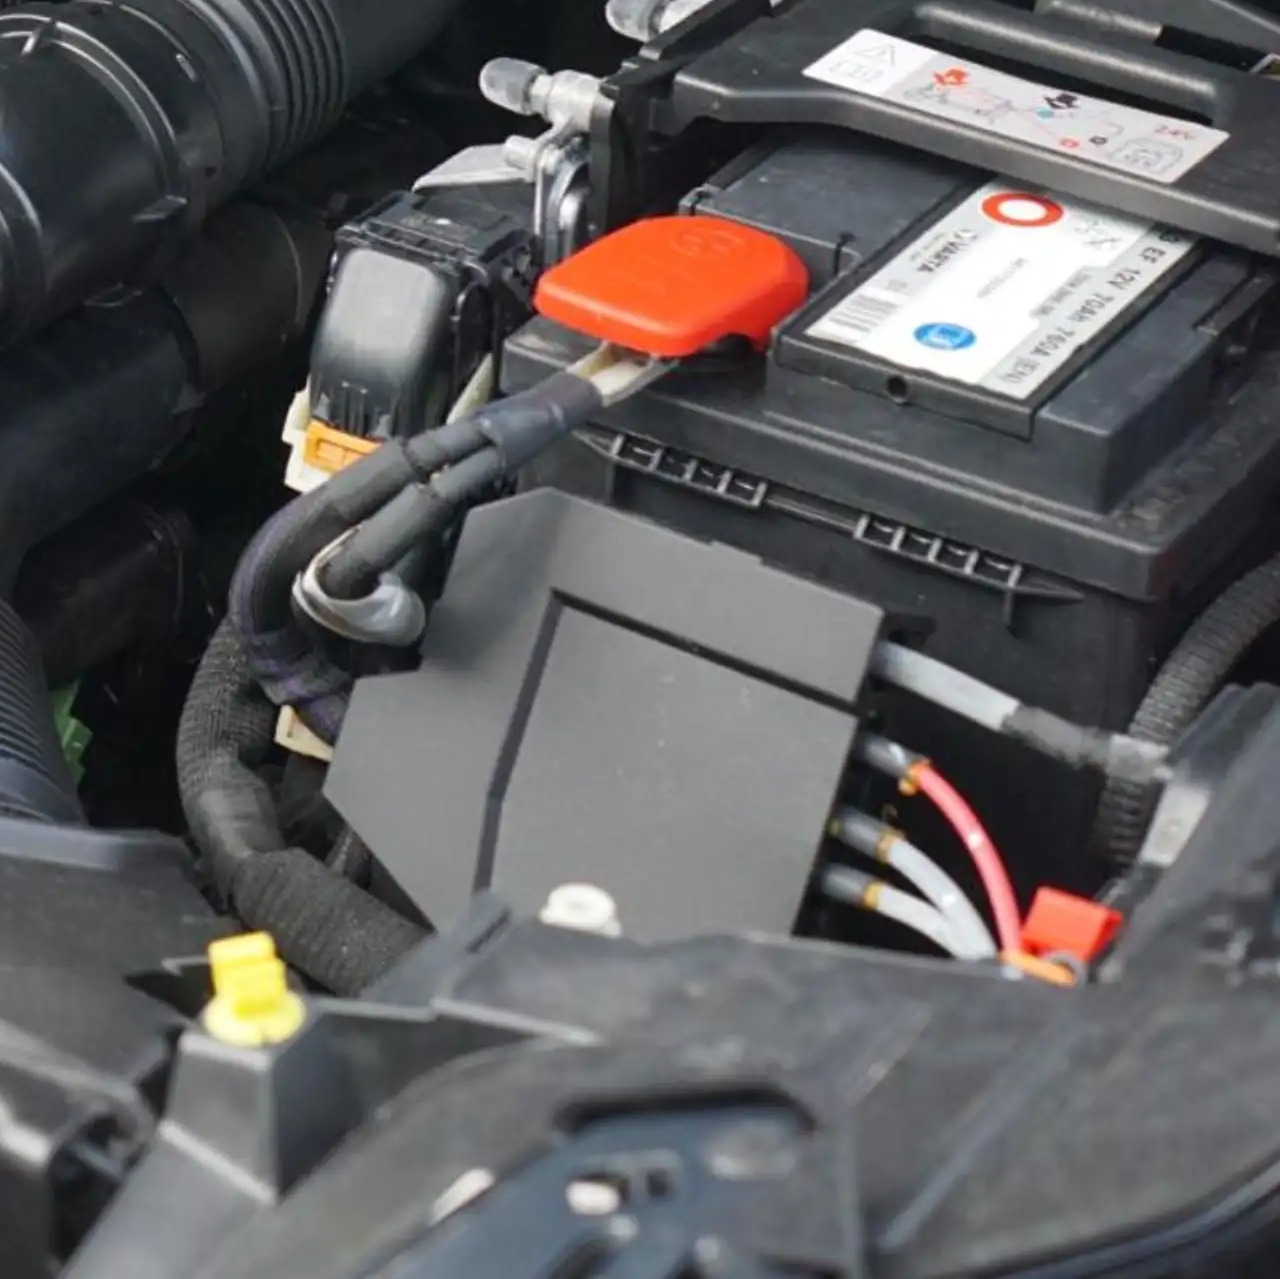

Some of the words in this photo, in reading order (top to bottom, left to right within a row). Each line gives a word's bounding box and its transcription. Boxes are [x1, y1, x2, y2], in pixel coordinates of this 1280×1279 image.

[917, 240, 970, 272] VARTA
[1107, 267, 1142, 291] 12V
[1066, 292, 1116, 323] 70Ah
